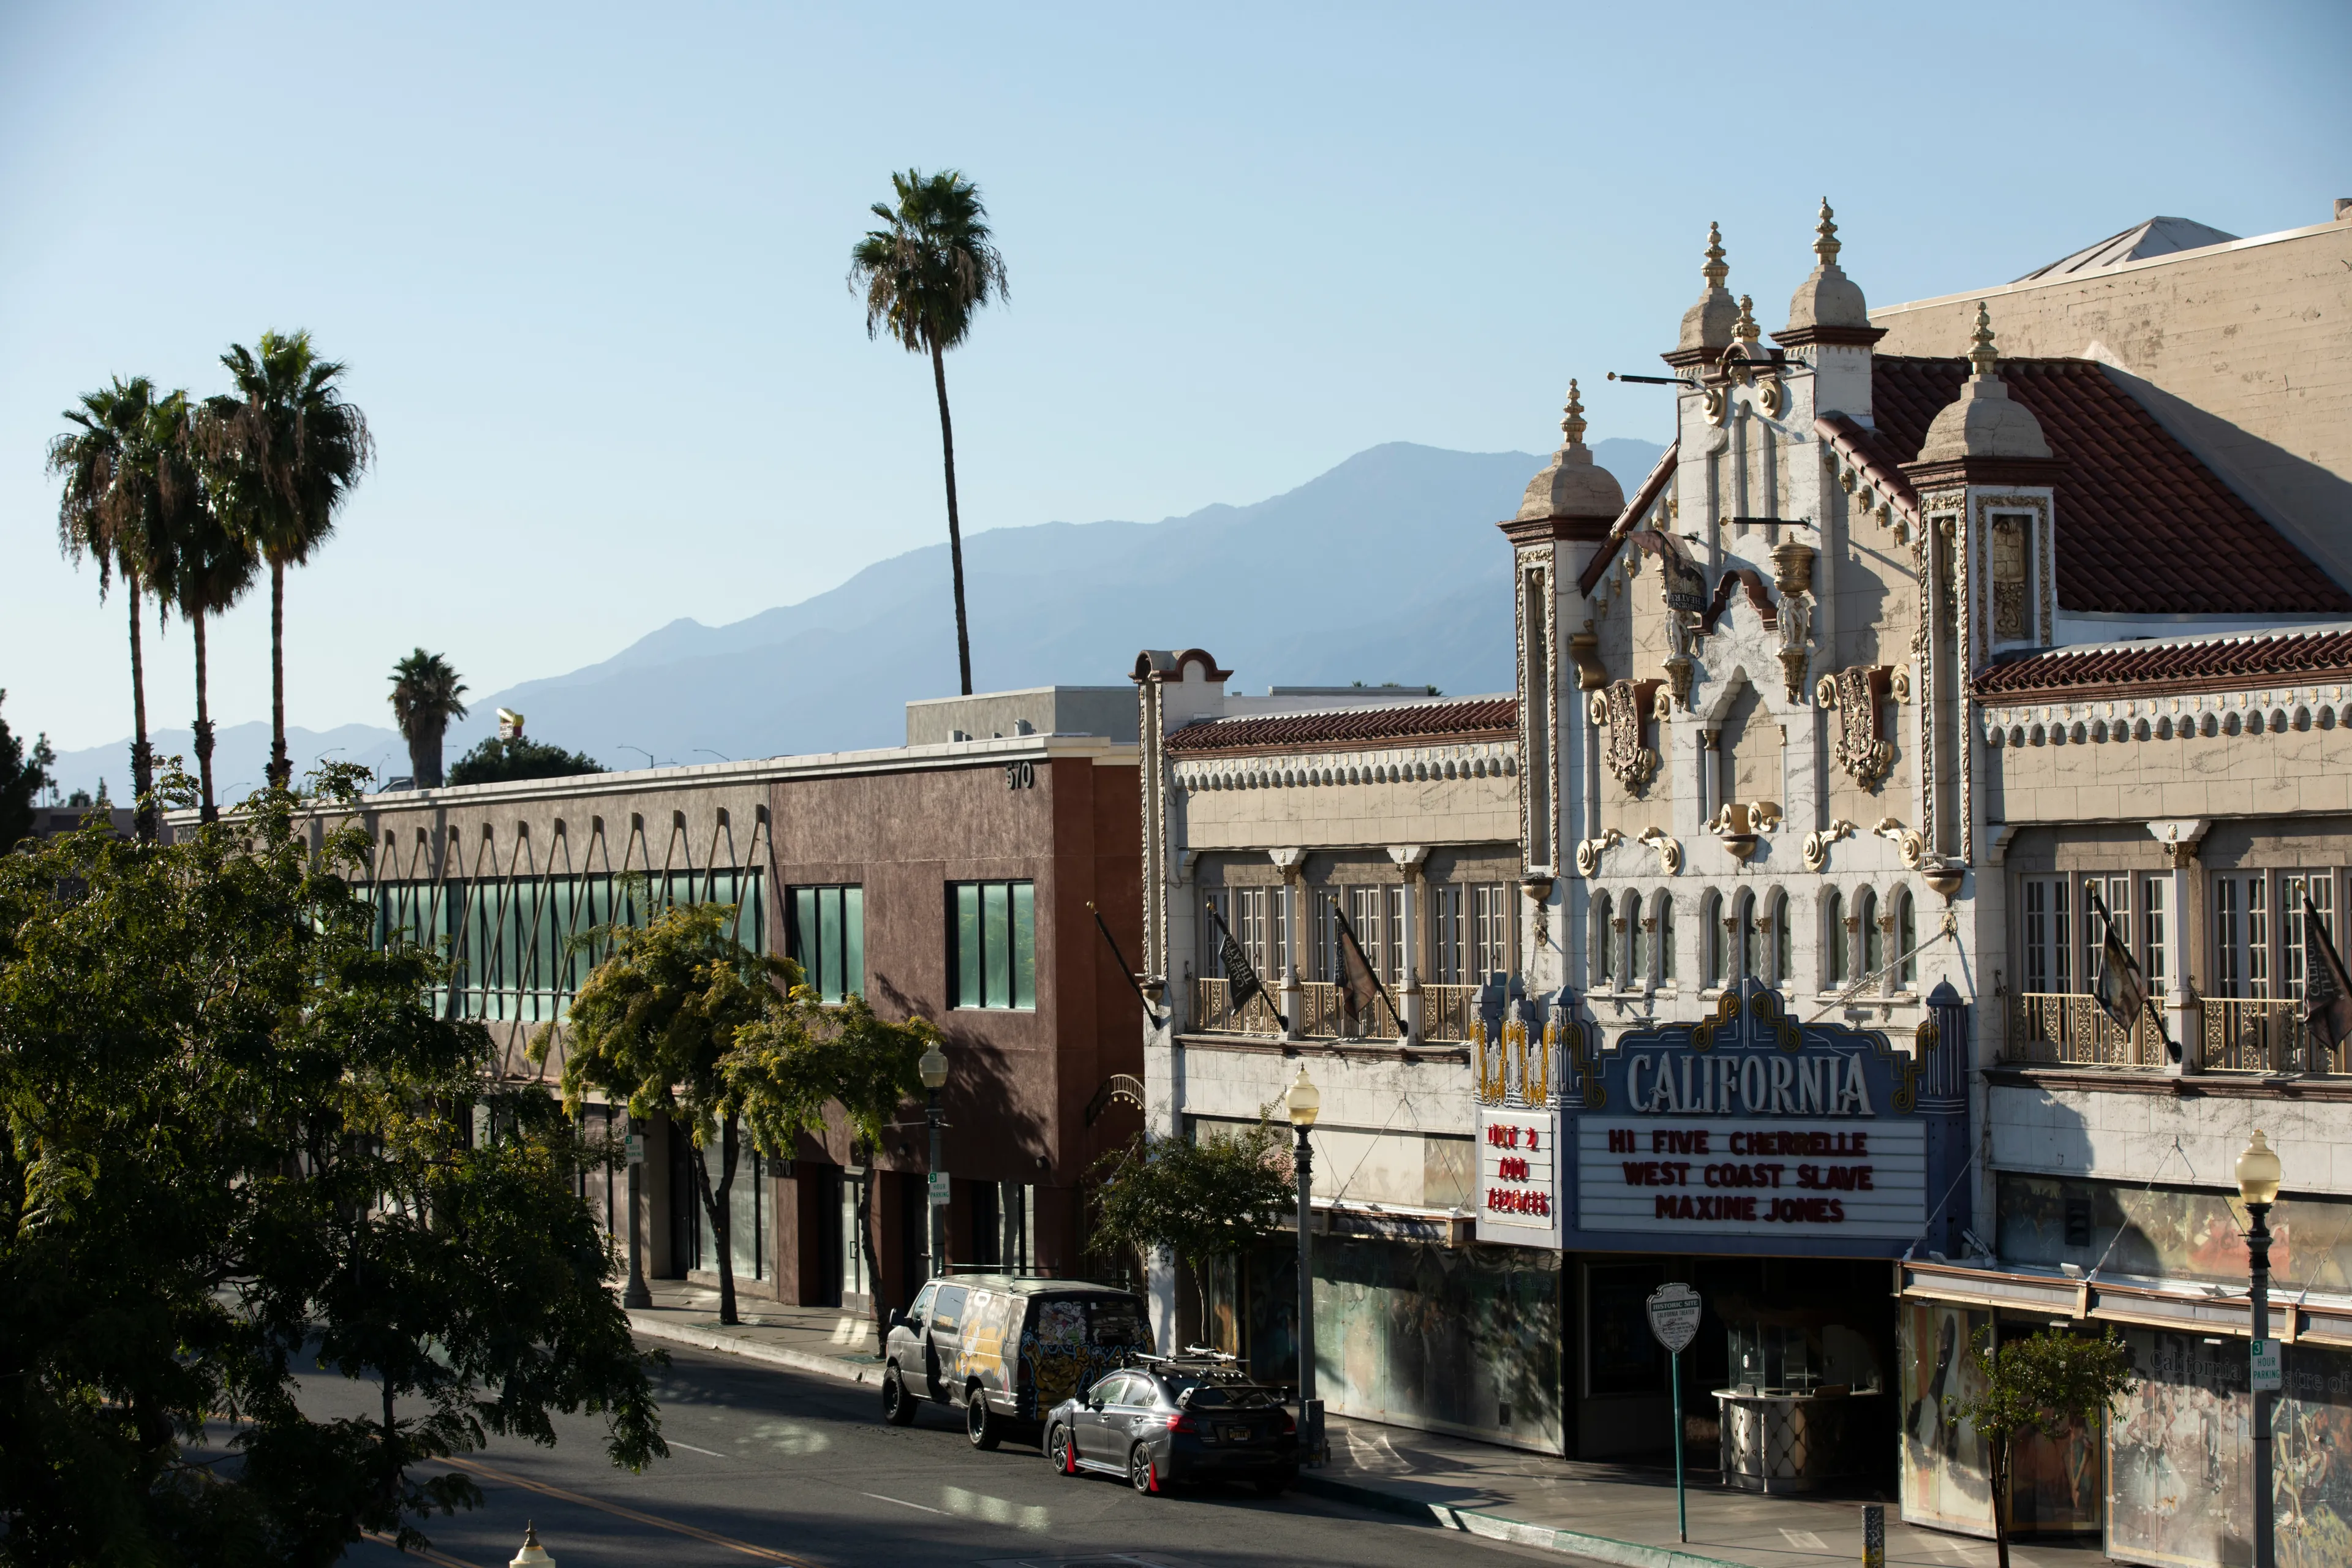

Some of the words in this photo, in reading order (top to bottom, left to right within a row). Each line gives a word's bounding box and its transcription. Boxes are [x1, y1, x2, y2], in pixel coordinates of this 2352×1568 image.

[1006, 761, 1032, 789] 570
[1627, 1050, 1875, 1115] CALIFORNIA
[1488, 1123, 1517, 1148] OCT
[1525, 1127, 1536, 1150] 2
[1608, 1129, 1635, 1153] HI
[1653, 1130, 1709, 1155] FIVE
[1729, 1131, 1867, 1156] CHERRELLE
[775, 1159, 791, 1176] 570
[1622, 1162, 1691, 1186] WEST
[1704, 1163, 1784, 1188] COAST
[1796, 1164, 1874, 1191] SLAVE
[1656, 1195, 1757, 1221] MAXINE
[1763, 1197, 1845, 1223] JONES
[1525, 1272, 1551, 1291] Arts
[2254, 1343, 2261, 1354] 3
[2258, 1357, 2275, 1366] HOUR
[2149, 1349, 2242, 1381] California
[2329, 1370, 2350, 1393] of
[2253, 1370, 2280, 1379] PARKING
